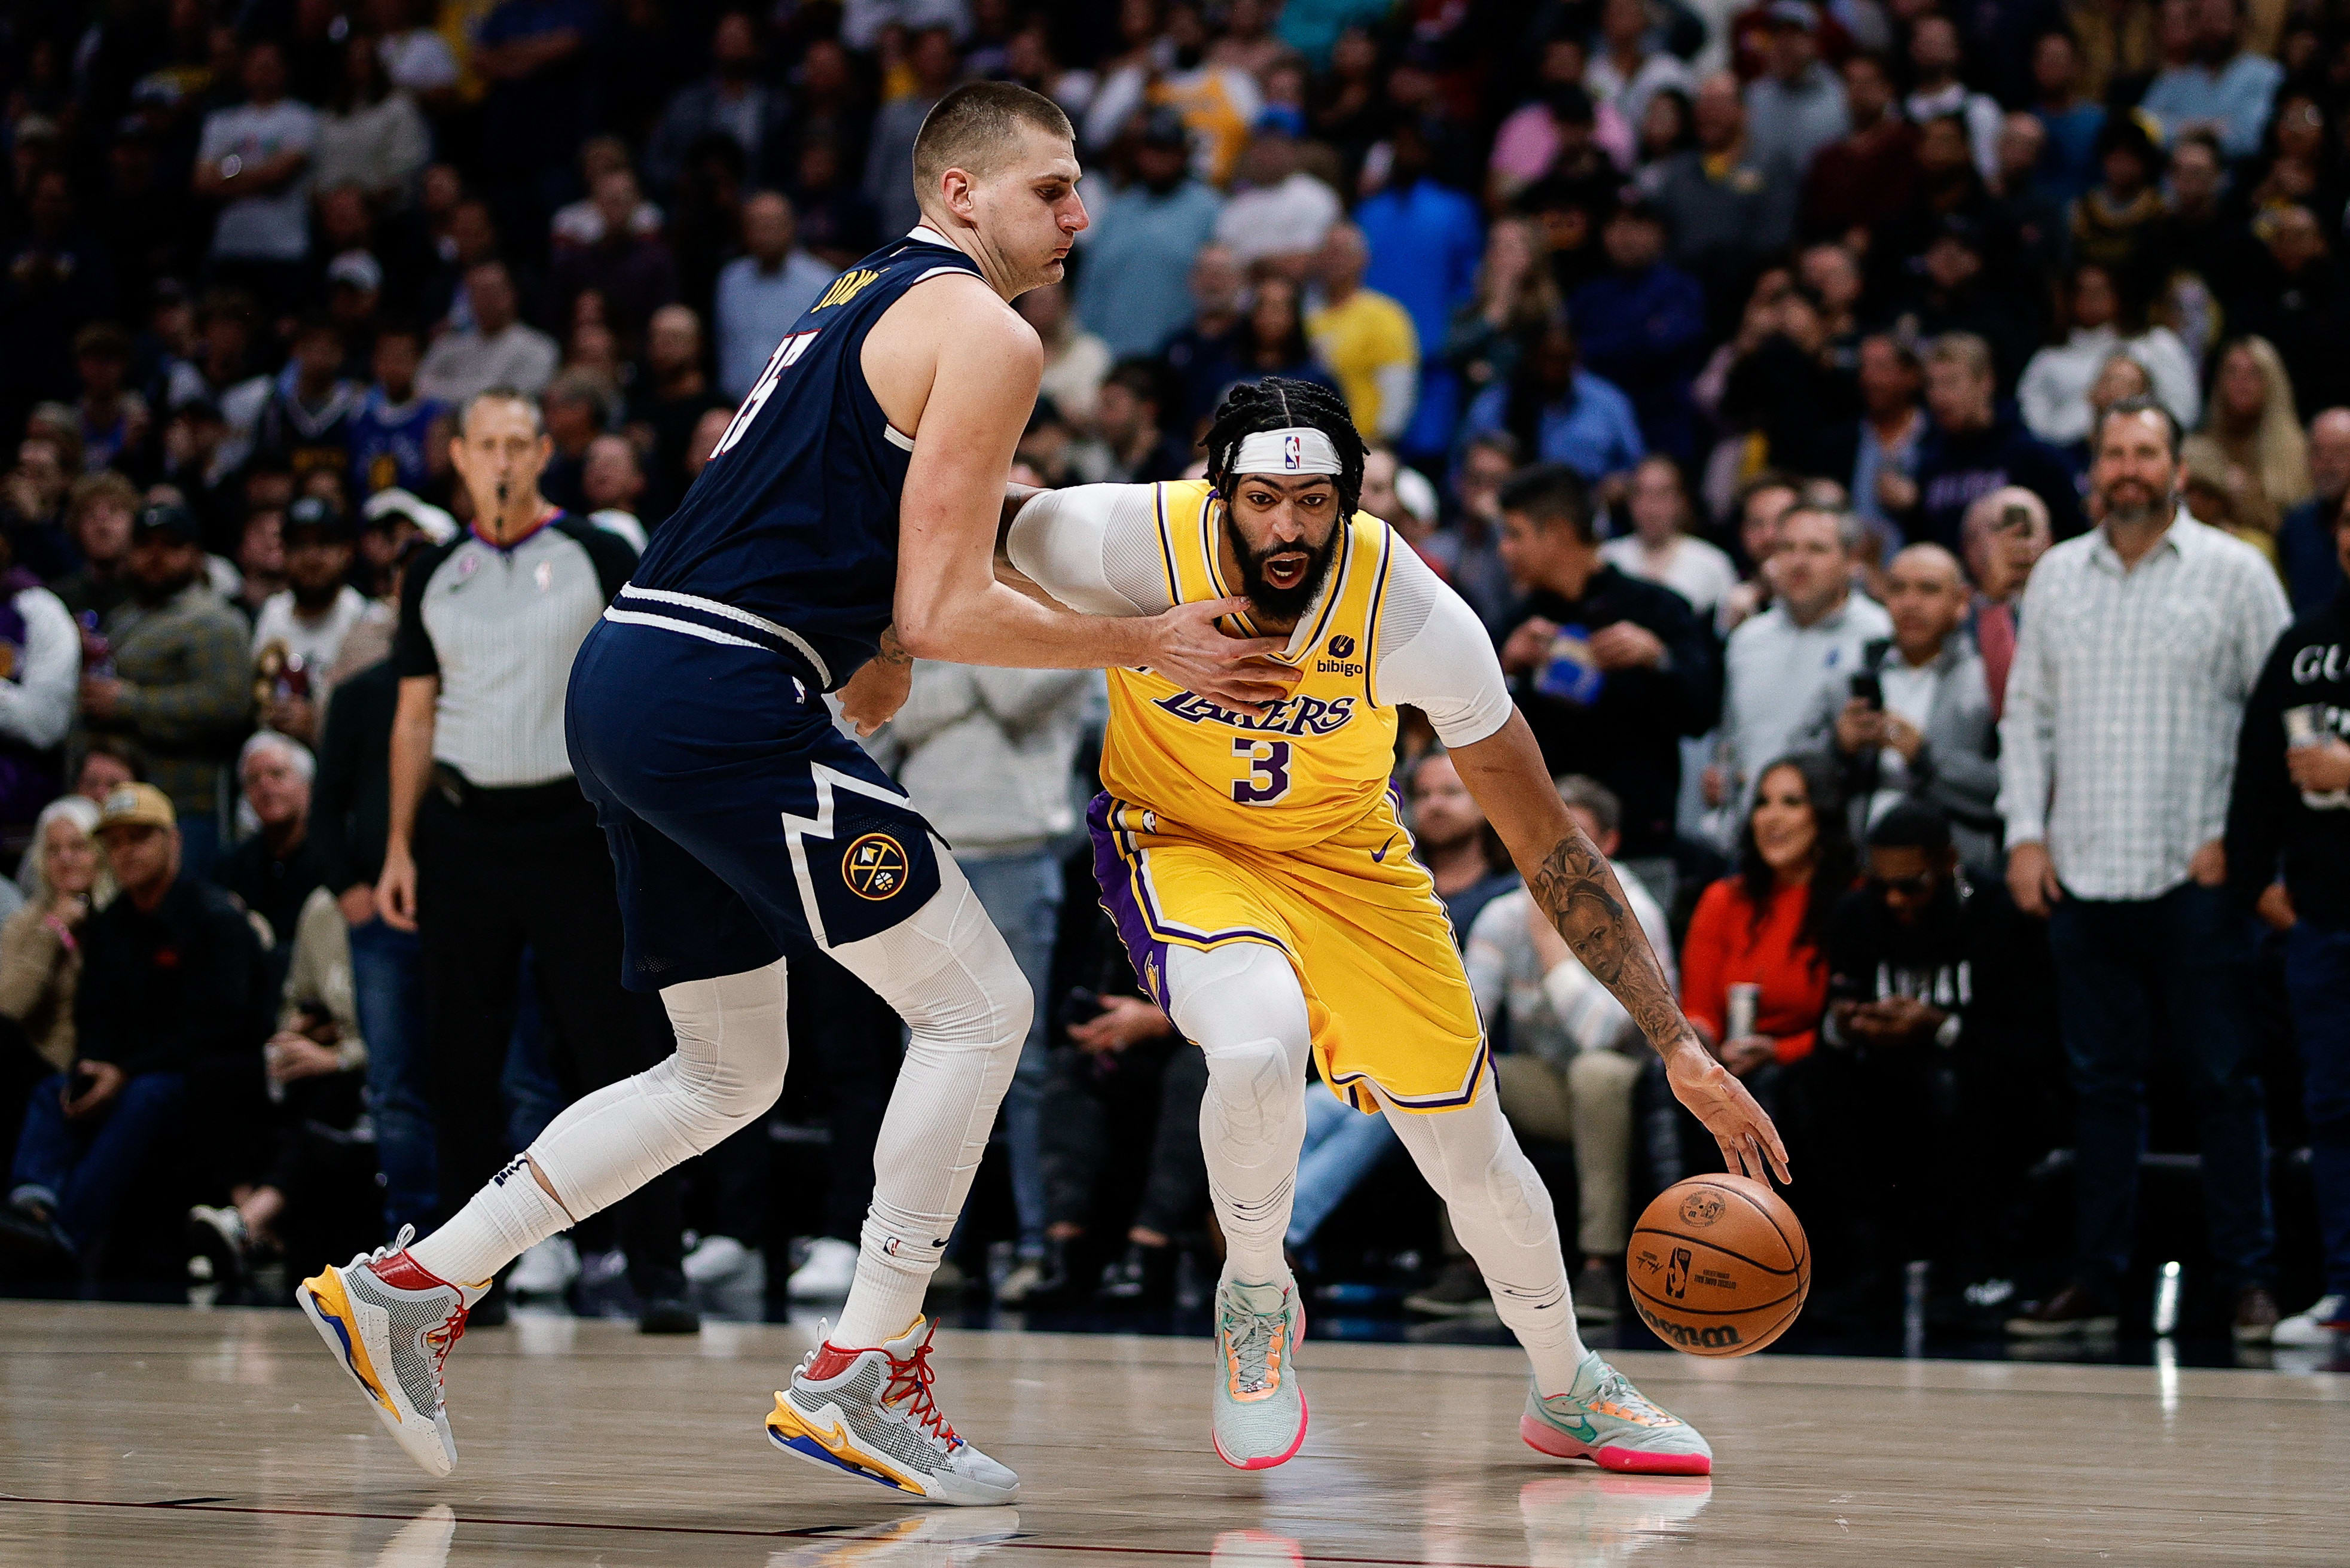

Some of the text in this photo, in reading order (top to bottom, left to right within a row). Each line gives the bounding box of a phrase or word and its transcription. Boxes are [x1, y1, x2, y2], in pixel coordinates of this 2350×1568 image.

[810, 267, 891, 314] JOK
[707, 328, 822, 461] 15
[1317, 659, 1363, 677] bibigo
[1231, 737, 1293, 807] 3
